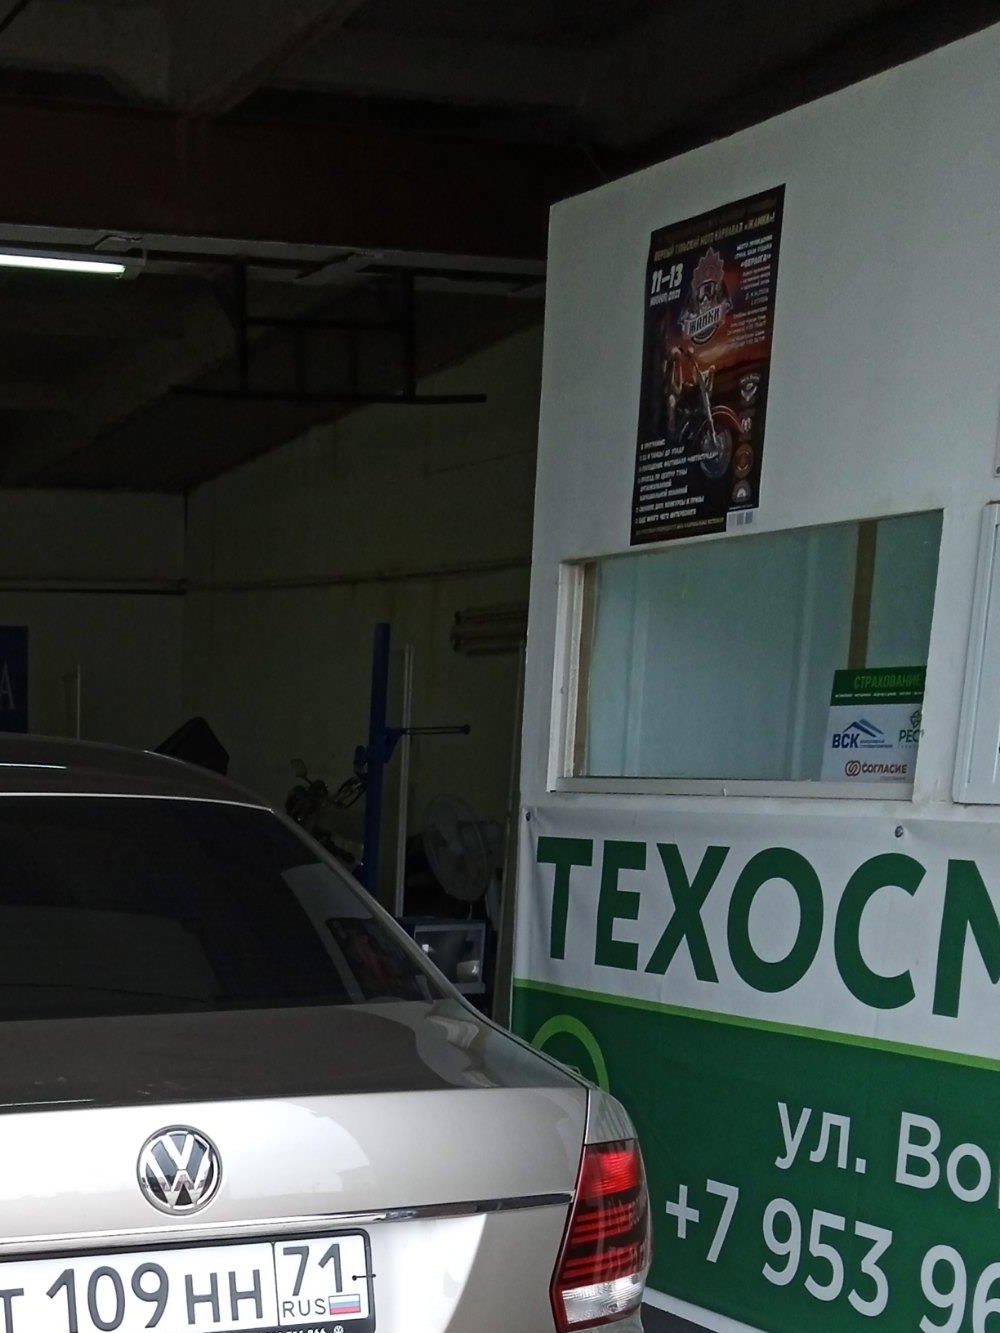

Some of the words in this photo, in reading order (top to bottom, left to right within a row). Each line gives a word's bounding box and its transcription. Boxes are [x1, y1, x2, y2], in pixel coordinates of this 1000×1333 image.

[832, 733, 860, 748] ВСК
[862, 761, 907, 774] СОГЛАСИЕ
[774, 1101, 867, 1174] ул.
[895, 1111, 1000, 1208] Во
[665, 1179, 739, 1264] +7
[762, 1197, 893, 1317] 953
[283, 1243, 343, 1297] 71
[283, 1298, 327, 1318] RUS
